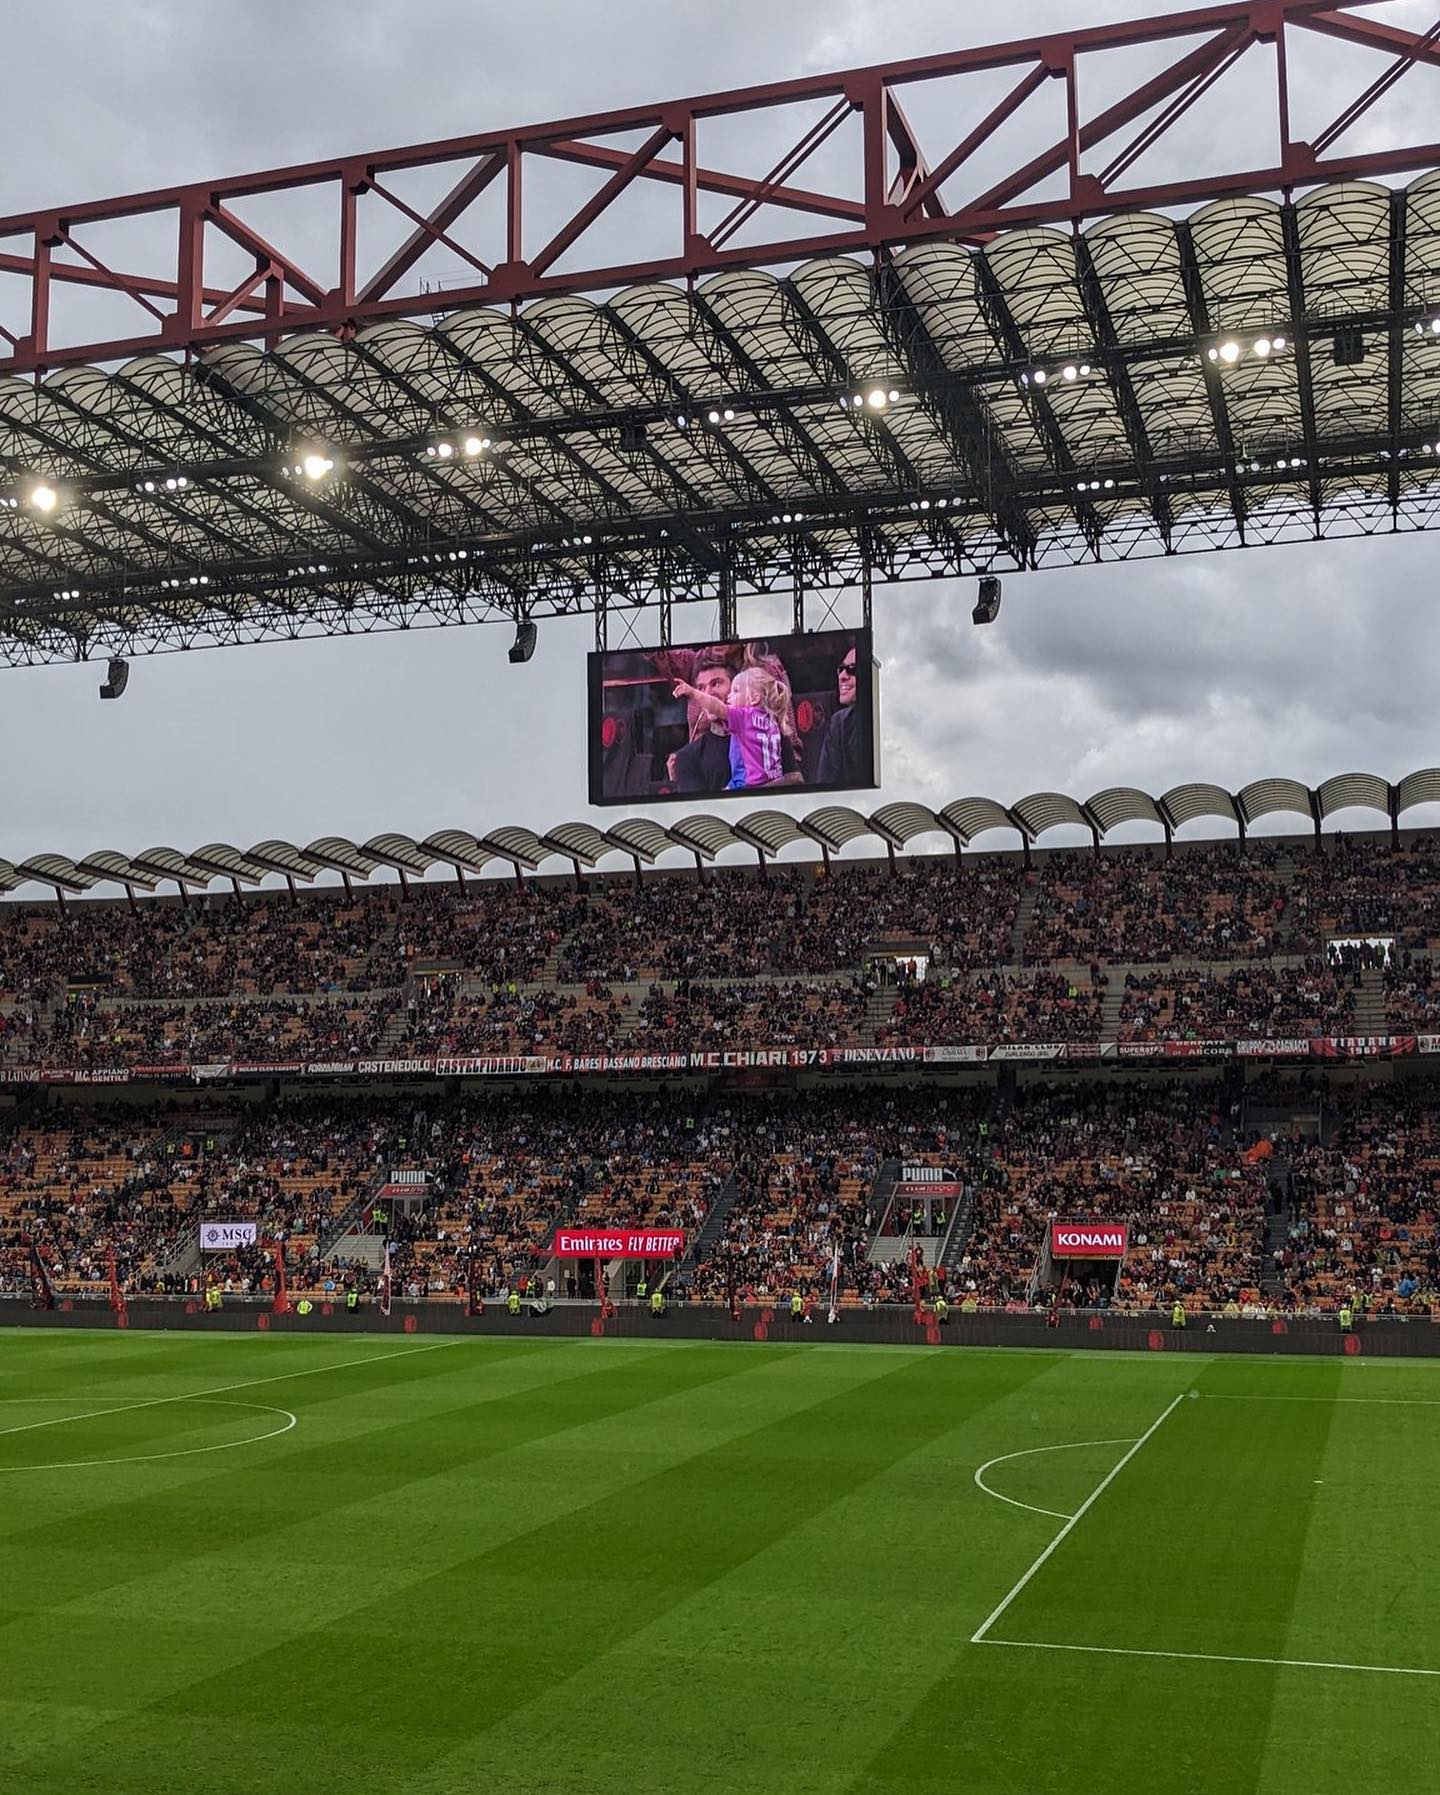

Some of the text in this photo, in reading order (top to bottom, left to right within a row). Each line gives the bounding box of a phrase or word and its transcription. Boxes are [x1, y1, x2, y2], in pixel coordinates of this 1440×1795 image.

[844, 1047, 915, 1062] DESENZANO
[437, 1058, 527, 1074] CASTELFIDARDO
[574, 1057, 601, 1070] BARESI
[603, 1056, 640, 1069] BASSANO
[641, 1055, 687, 1068] BRESCIANO
[91, 1068, 129, 1076] APPIANO
[391, 1170, 426, 1183] PUMA
[902, 1167, 943, 1181] PUMA
[222, 1229, 251, 1240] MSC
[1057, 1233, 1122, 1246] KONAMI
[560, 1236, 623, 1251] Emirates
[628, 1236, 645, 1252] FLY
